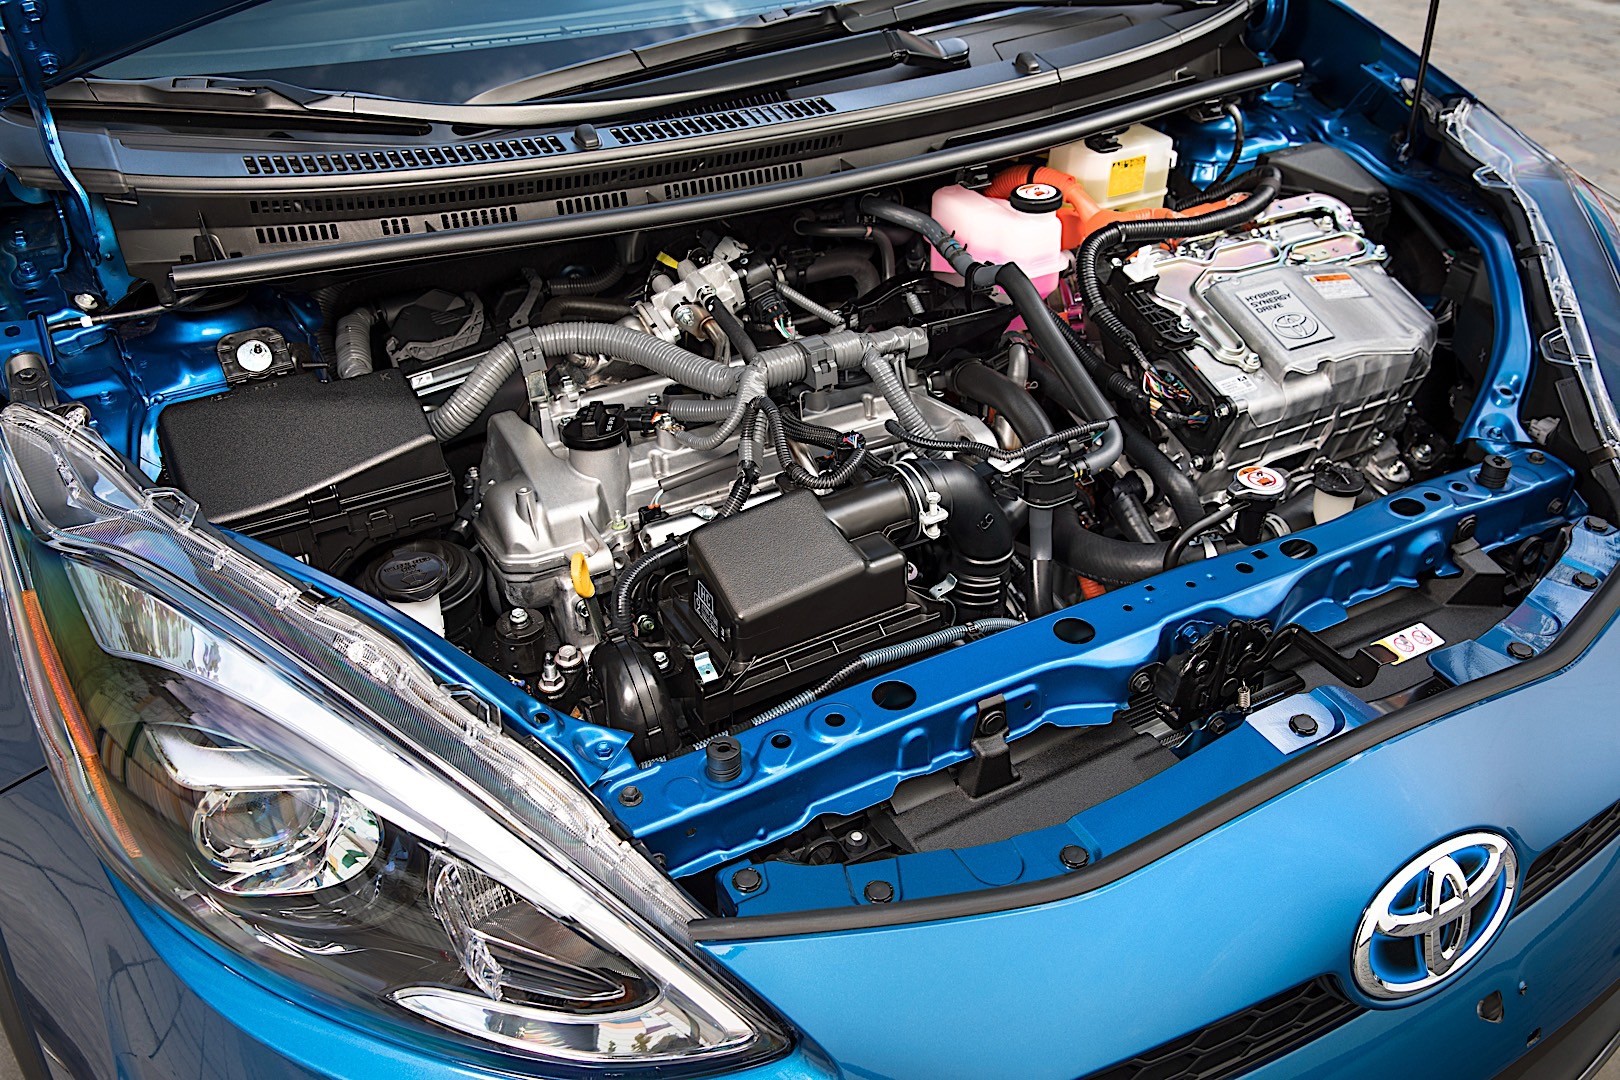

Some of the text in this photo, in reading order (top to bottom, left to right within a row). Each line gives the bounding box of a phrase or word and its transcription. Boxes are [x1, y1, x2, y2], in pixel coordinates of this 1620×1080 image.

[1245, 289, 1280, 302] HYBRID
[1250, 293, 1292, 307] SYNERGY
[1255, 303, 1284, 313] DRIVE
[700, 586, 711, 608] HC
